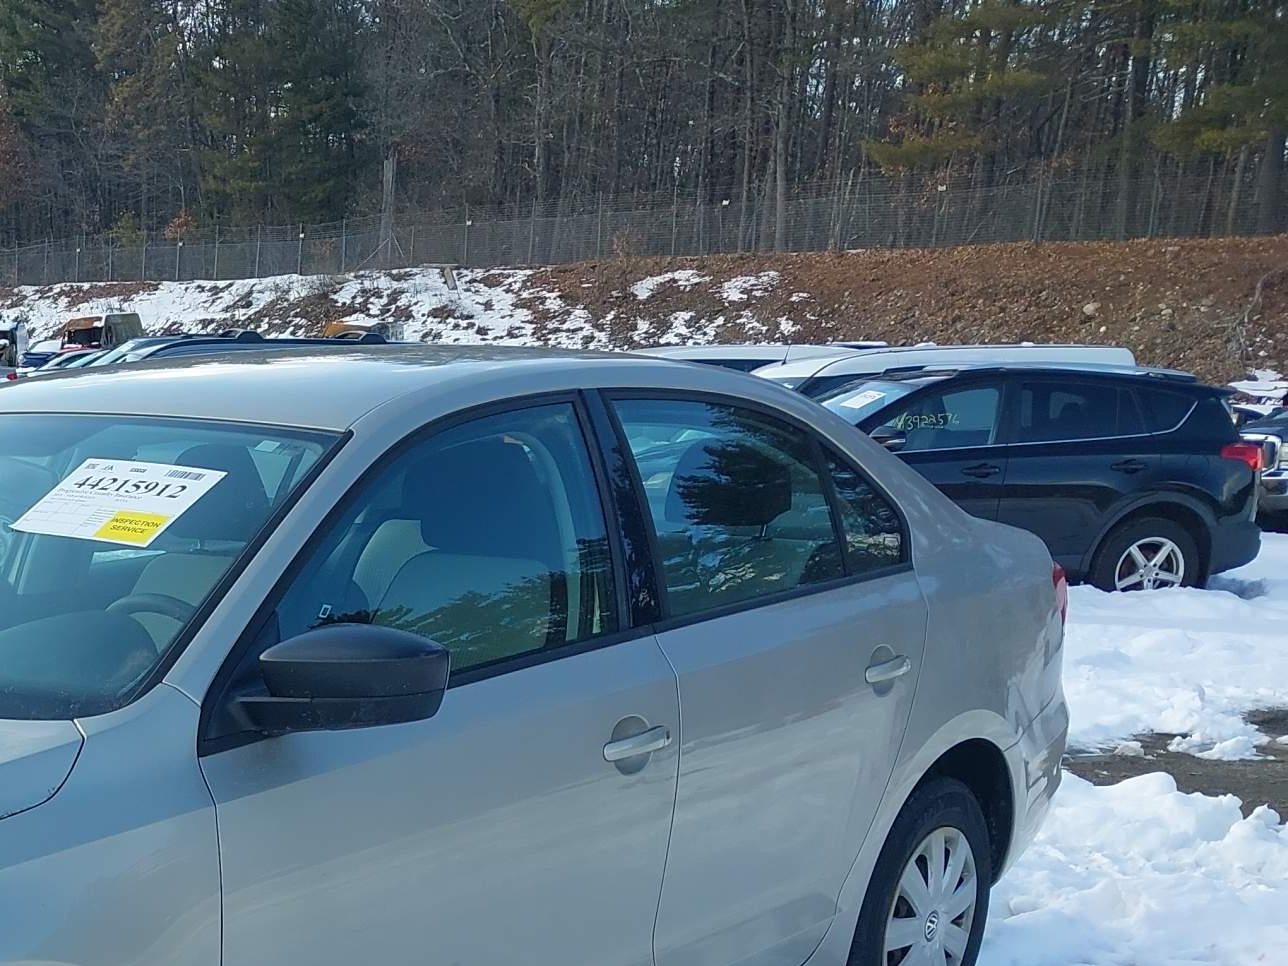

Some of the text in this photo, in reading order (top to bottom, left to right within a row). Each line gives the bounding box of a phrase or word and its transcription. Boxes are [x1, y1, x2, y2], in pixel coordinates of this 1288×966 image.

[73, 475, 187, 499] 44215912
[111, 517, 161, 529] INSPECTION
[110, 525, 149, 535] SERVICE
